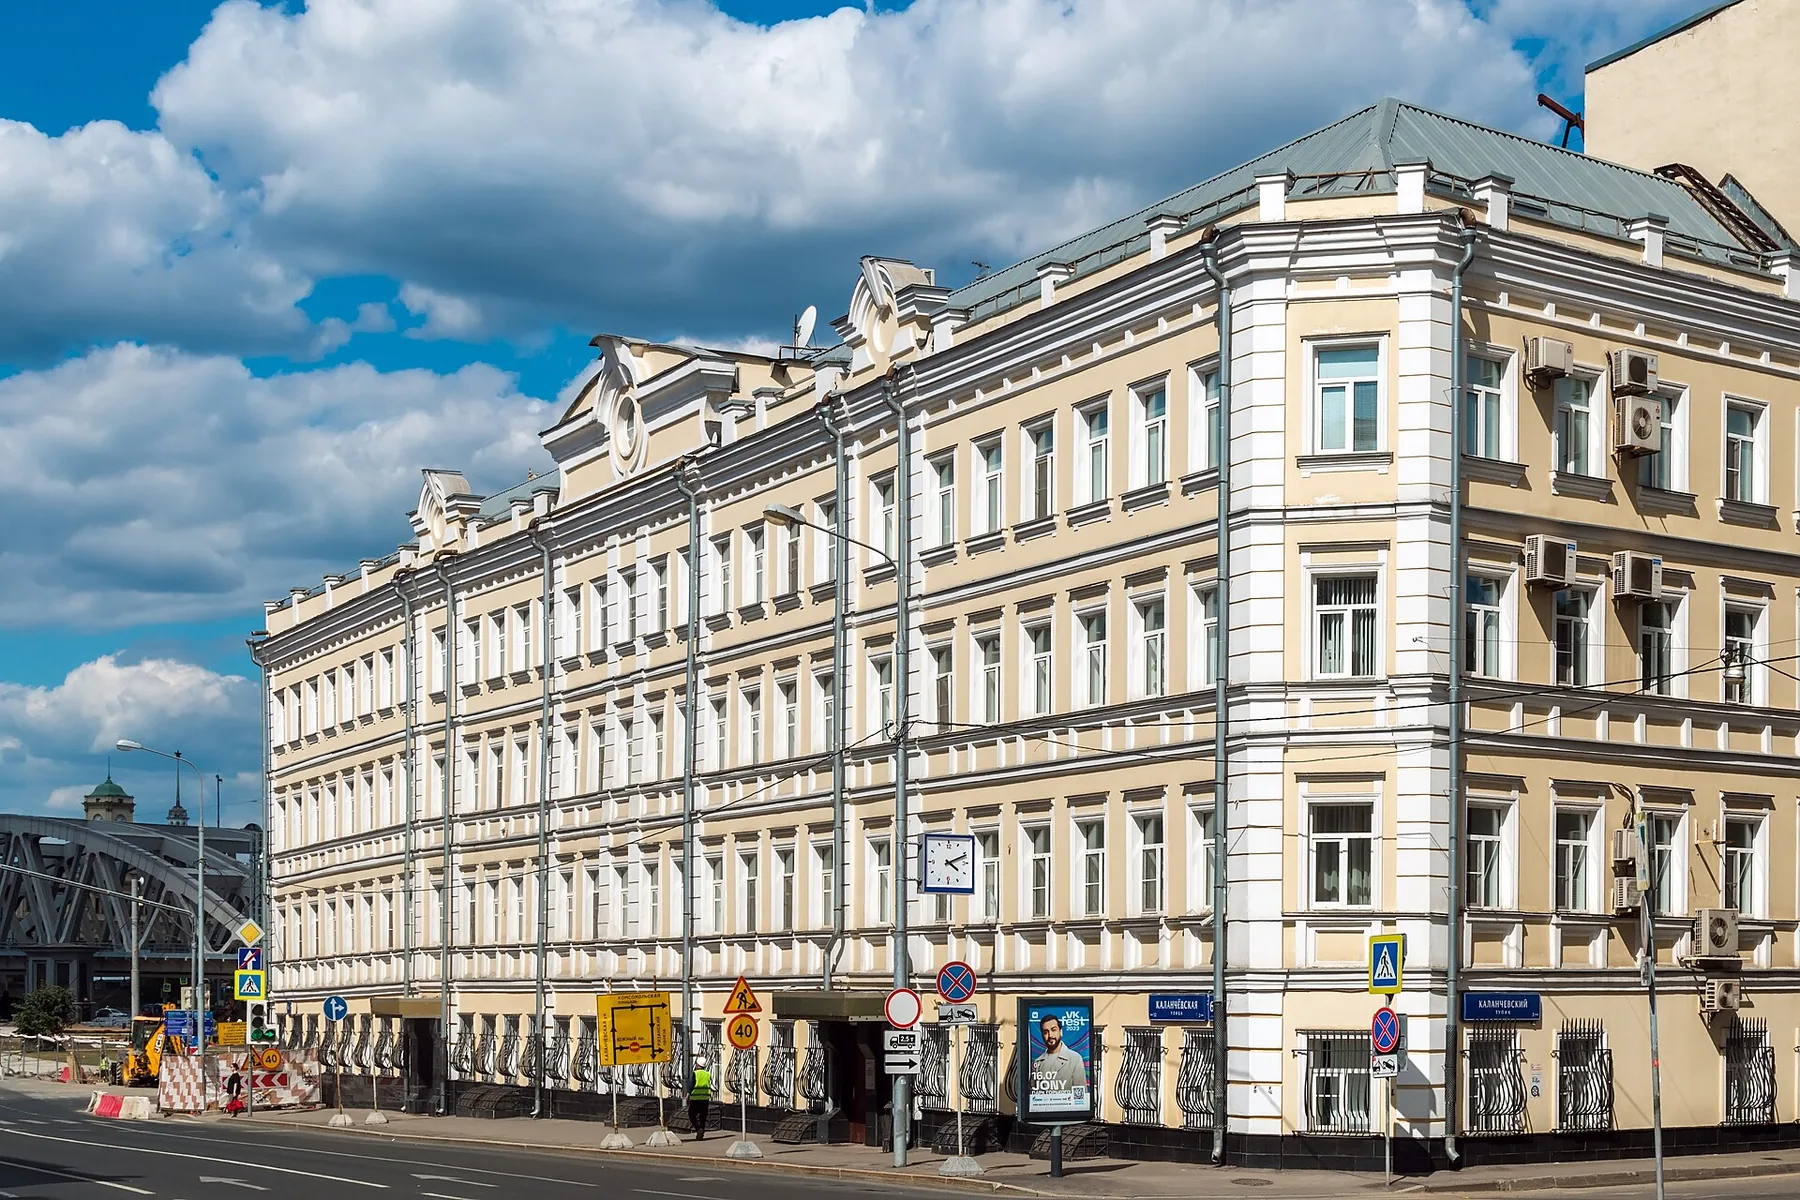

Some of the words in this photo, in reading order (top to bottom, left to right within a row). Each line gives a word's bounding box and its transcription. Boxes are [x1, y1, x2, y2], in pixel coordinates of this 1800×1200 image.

[1156, 998, 1198, 1010] КАЛАНЧЁВСКАЯ
[1478, 999, 1528, 1008] КАЛАНЧЕВСКИЙ
[1062, 1016, 1085, 1026] fest
[735, 1024, 752, 1038] 40
[155, 1034, 163, 1054] JCB
[265, 1054, 277, 1063] 40
[1032, 1071, 1058, 1080] 16.07
[1032, 1080, 1068, 1090] JONY
